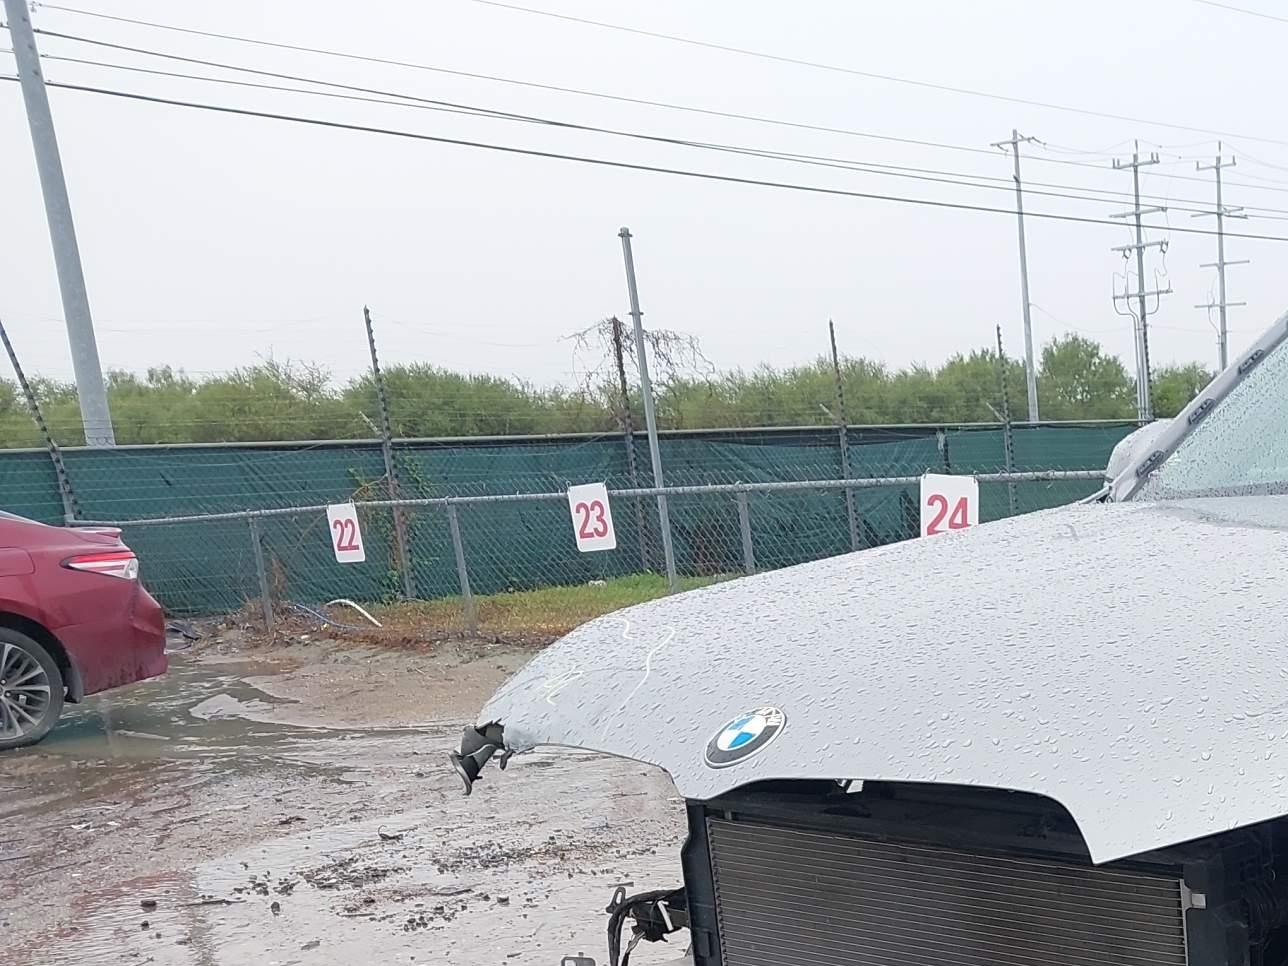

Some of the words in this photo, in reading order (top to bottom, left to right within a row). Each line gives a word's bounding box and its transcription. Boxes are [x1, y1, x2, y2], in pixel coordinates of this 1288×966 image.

[576, 500, 608, 539] 23
[926, 493, 973, 537] 24
[332, 519, 360, 552] 22
